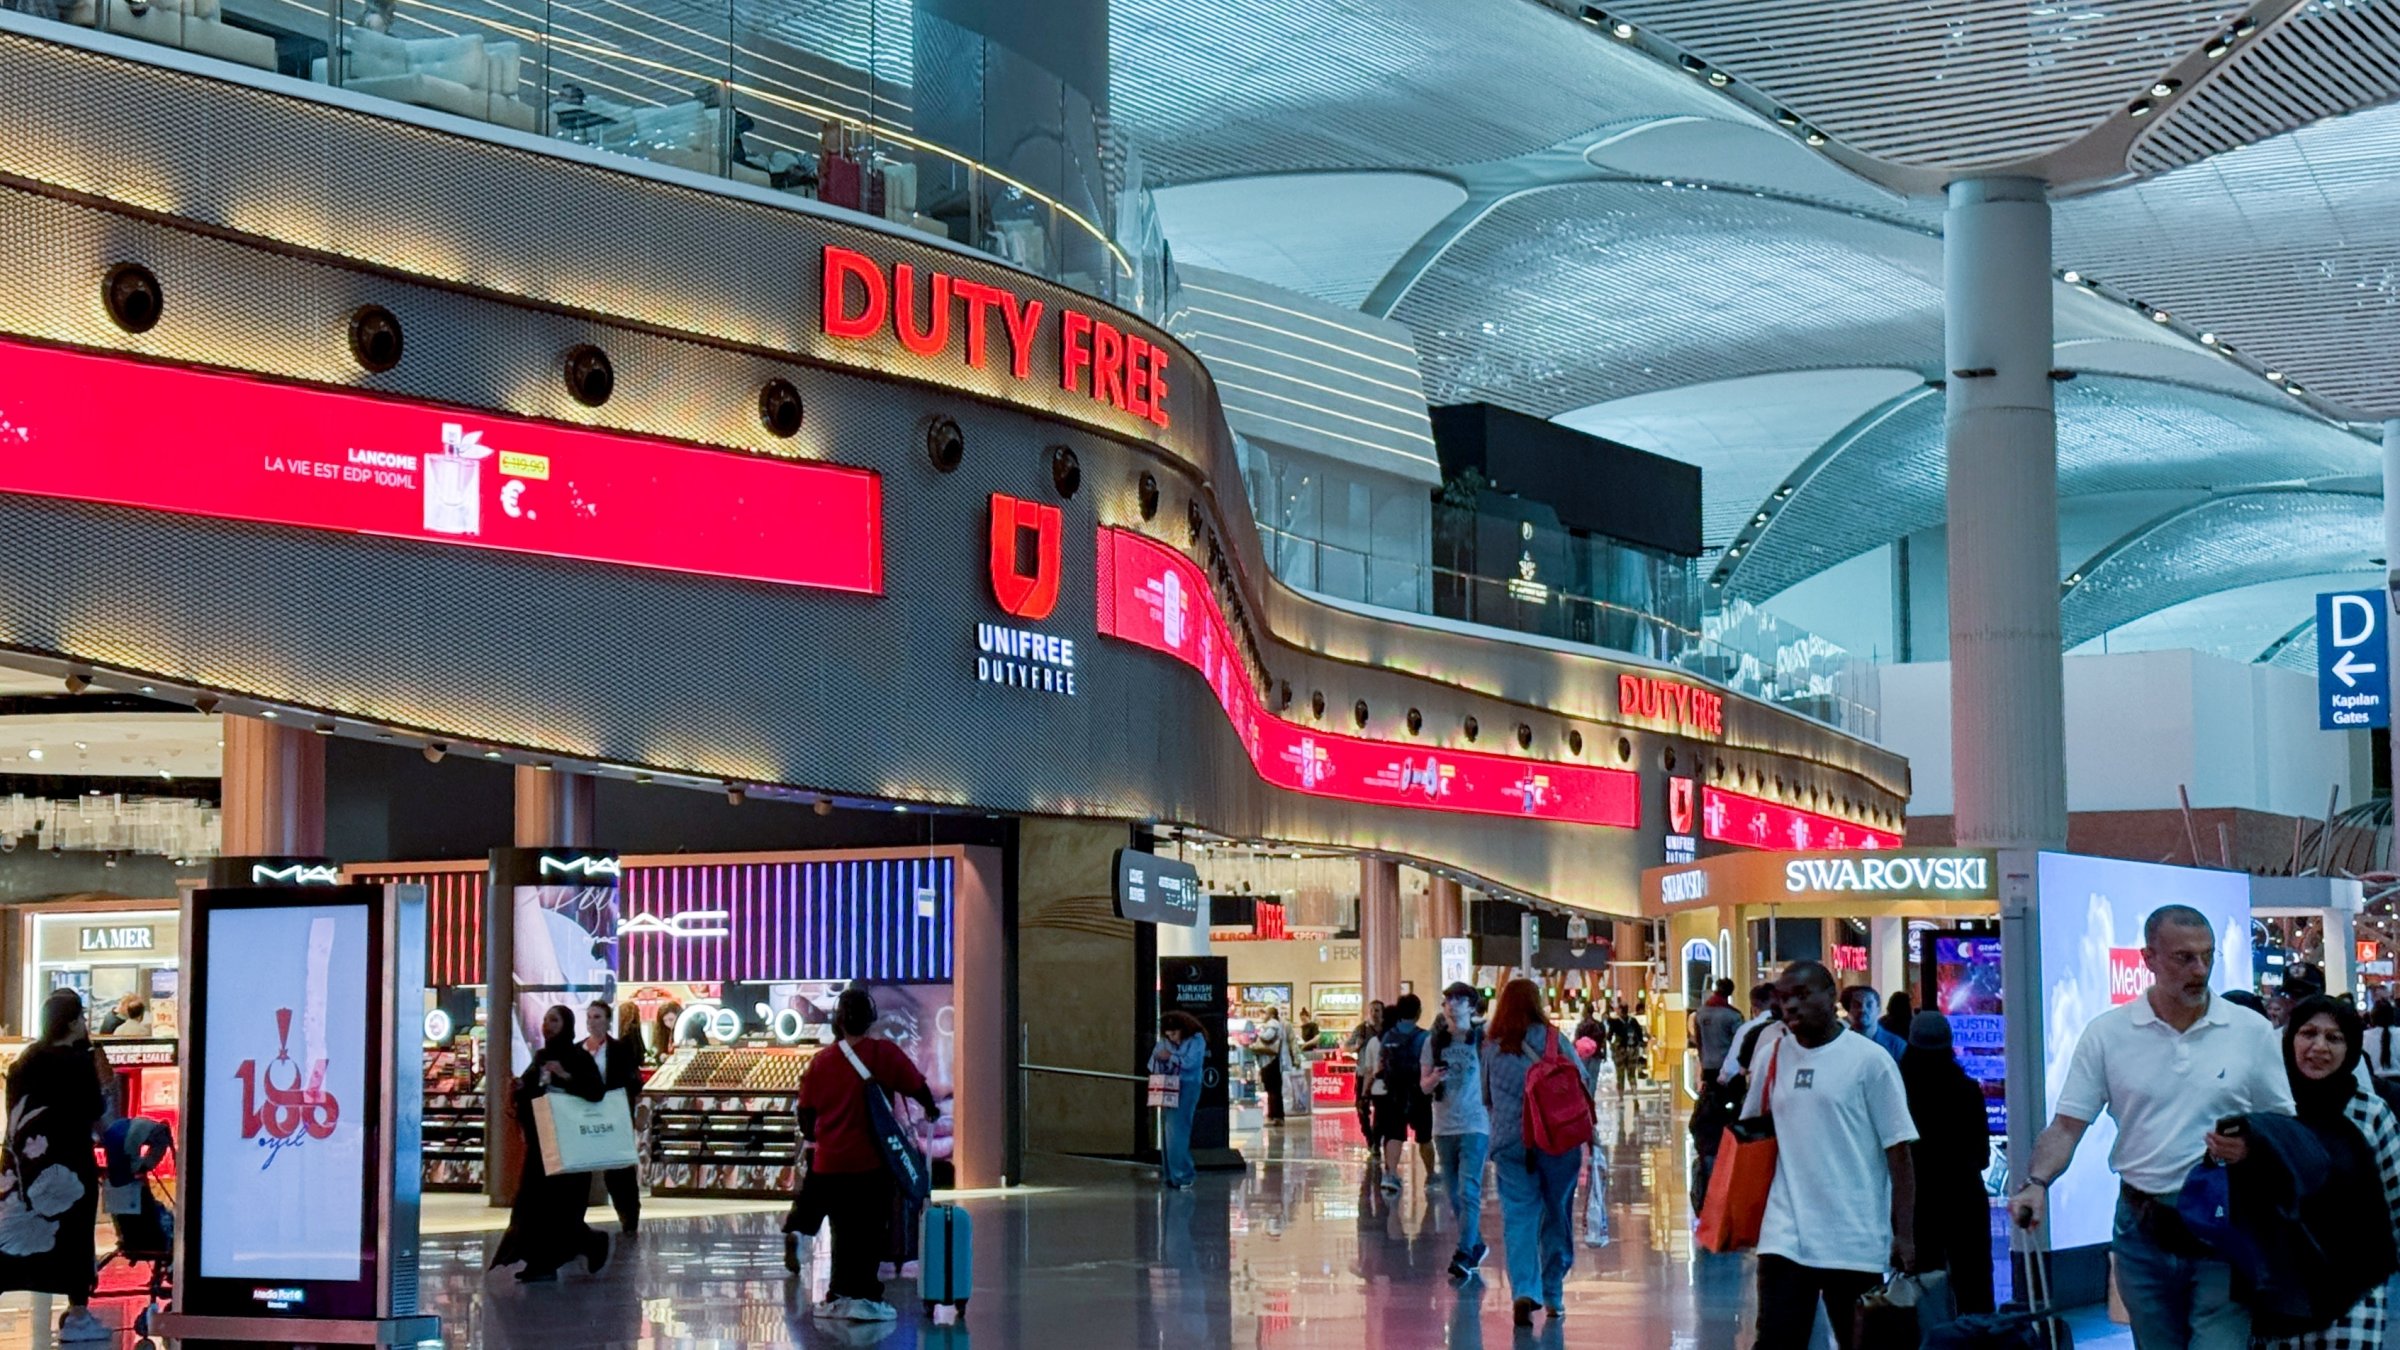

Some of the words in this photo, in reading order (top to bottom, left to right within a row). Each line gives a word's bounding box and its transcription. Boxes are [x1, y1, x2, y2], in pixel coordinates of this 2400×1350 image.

[824, 245, 1043, 379] DUTY
[1061, 310, 1170, 429] FREE
[348, 448, 417, 470] LANCOME
[264, 456, 285, 472] LA
[287, 459, 311, 475] VIE
[314, 462, 340, 479] EST
[343, 466, 372, 484] EDP
[374, 470, 416, 489] 100ML
[2332, 595, 2375, 647] D
[978, 623, 1075, 666] UNIFREE
[978, 657, 1076, 695] DUTYFREE
[1619, 674, 1690, 725] DUTY
[1690, 689, 1722, 735] FREE
[2333, 711, 2370, 724] Gates
[252, 864, 338, 884] MA
[1786, 858, 1988, 891] SWAROVSKI
[82, 928, 107, 949] LA
[110, 927, 153, 948] MER
[1176, 984, 1213, 993] TURKISH
[1176, 993, 1213, 1002] AIRLINES
[1953, 1018, 2000, 1030] JUSTIN
[579, 1124, 615, 1135] BLUSH
